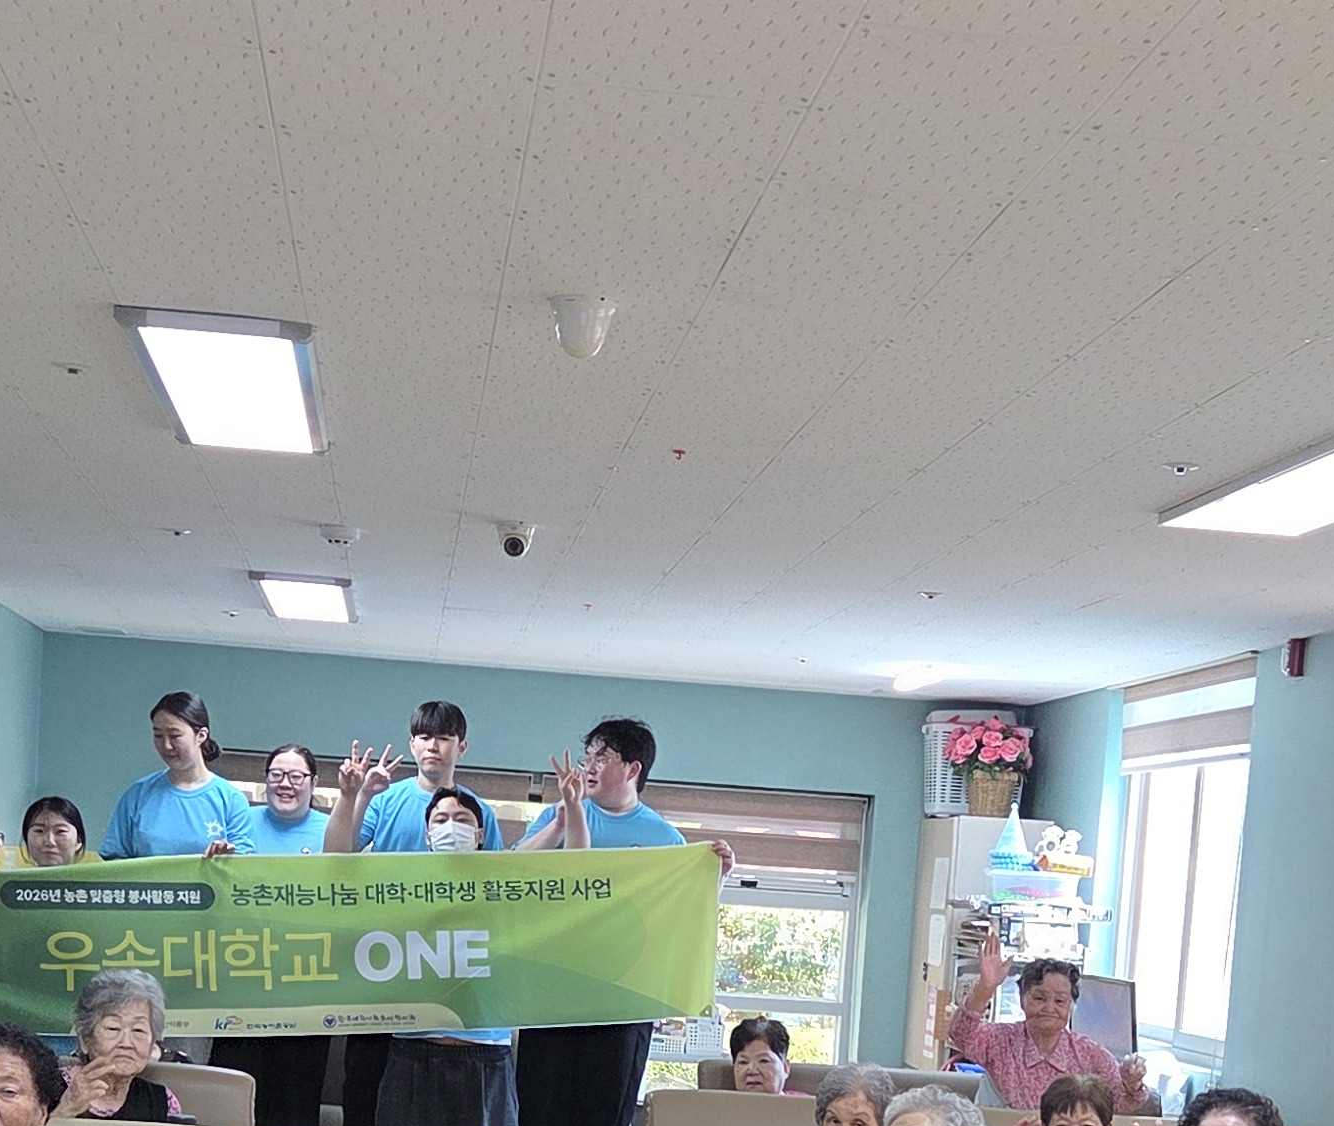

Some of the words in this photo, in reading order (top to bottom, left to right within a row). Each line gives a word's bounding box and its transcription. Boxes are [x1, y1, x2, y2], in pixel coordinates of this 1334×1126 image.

[15, 888, 62, 903] 2026년
[63, 888, 89, 904] 농촌
[89, 888, 126, 905] 맞춤형
[128, 889, 175, 905] 봉사활동
[176, 889, 202, 905] 지원
[230, 882, 360, 907] 농촌재능나눔
[364, 880, 477, 904] 대학·대학생
[481, 878, 566, 902] 활동지원
[570, 876, 612, 900] 사업
[353, 929, 492, 983] ONE
